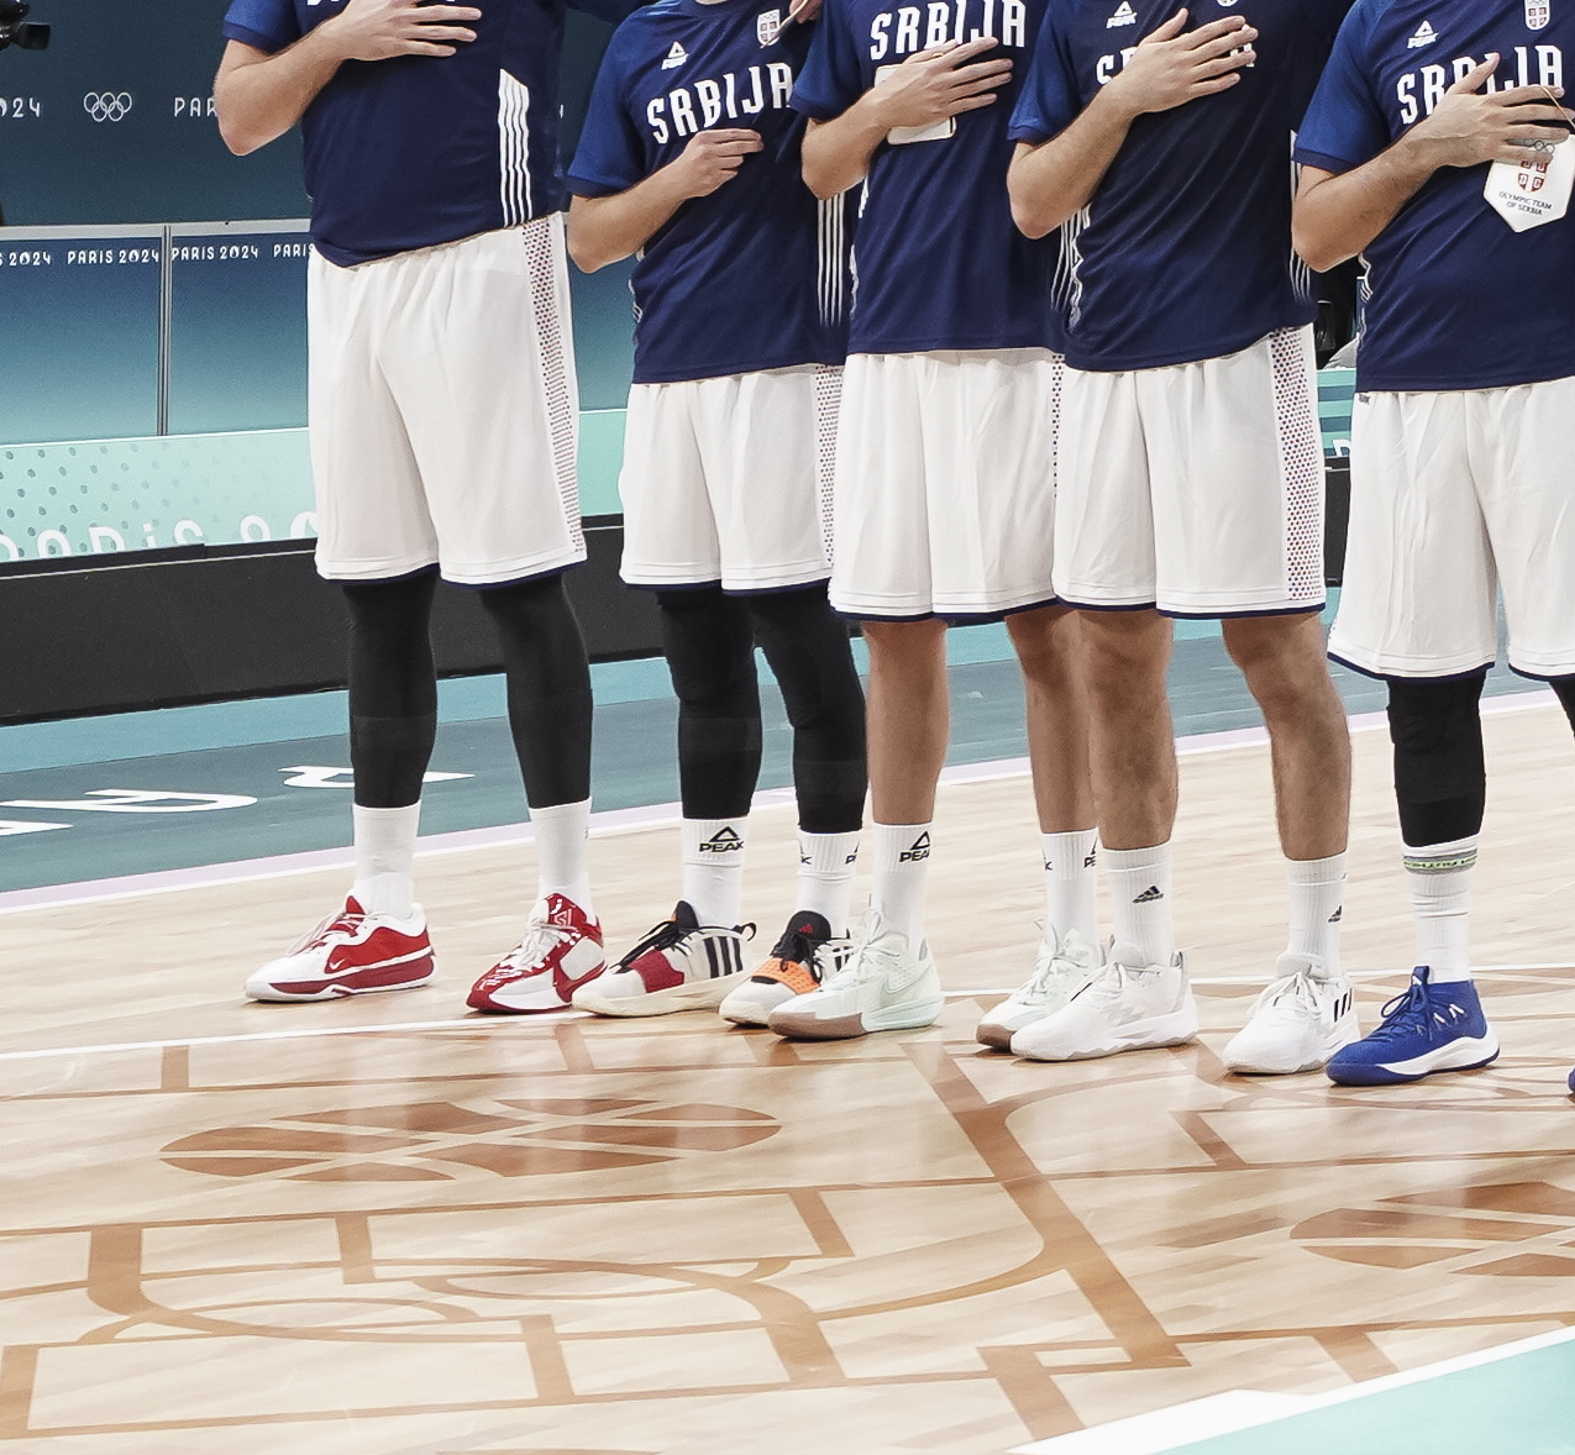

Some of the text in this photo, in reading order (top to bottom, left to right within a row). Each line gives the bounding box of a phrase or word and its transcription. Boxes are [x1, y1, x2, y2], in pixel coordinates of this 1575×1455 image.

[0, 96, 41, 118] 024
[174, 96, 218, 117] PAR
[646, 62, 796, 145] SRBIJA
[1506, 201, 1516, 210] OF
[9, 251, 51, 265] 2024
[67, 249, 160, 265] PARIS 2024
[171, 245, 259, 262] PARIS 2024
[699, 840, 744, 854] PEAK
[899, 849, 931, 864] PEA
